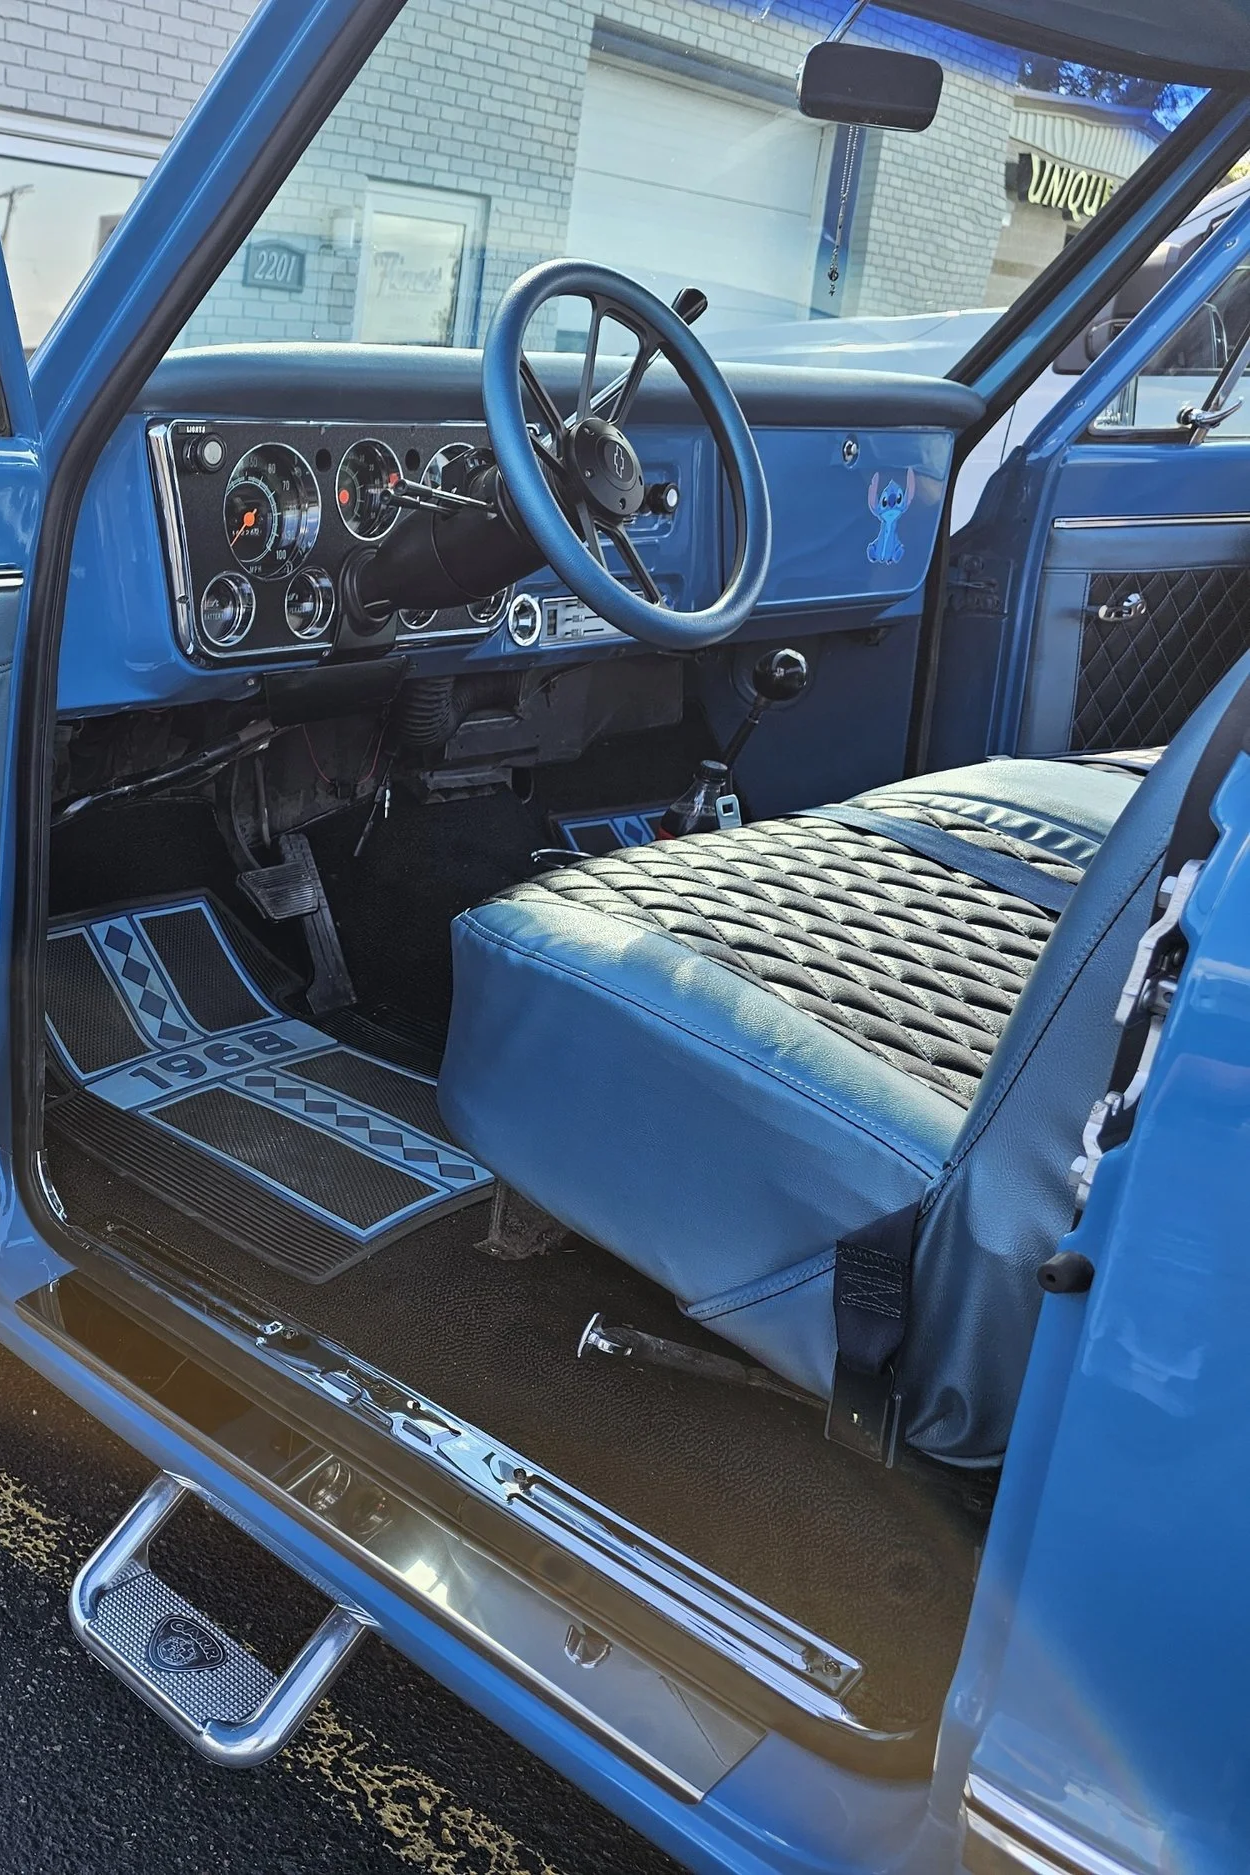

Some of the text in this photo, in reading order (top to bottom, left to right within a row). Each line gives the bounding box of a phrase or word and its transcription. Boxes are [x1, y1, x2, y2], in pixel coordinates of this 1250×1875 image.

[254, 250, 297, 283] 2201
[186, 426, 206, 434] LIGHTS
[282, 480, 290, 491] 70
[276, 549, 287, 560] 100
[126, 1029, 299, 1090] 1968
[170, 1621, 220, 1661] CARR
